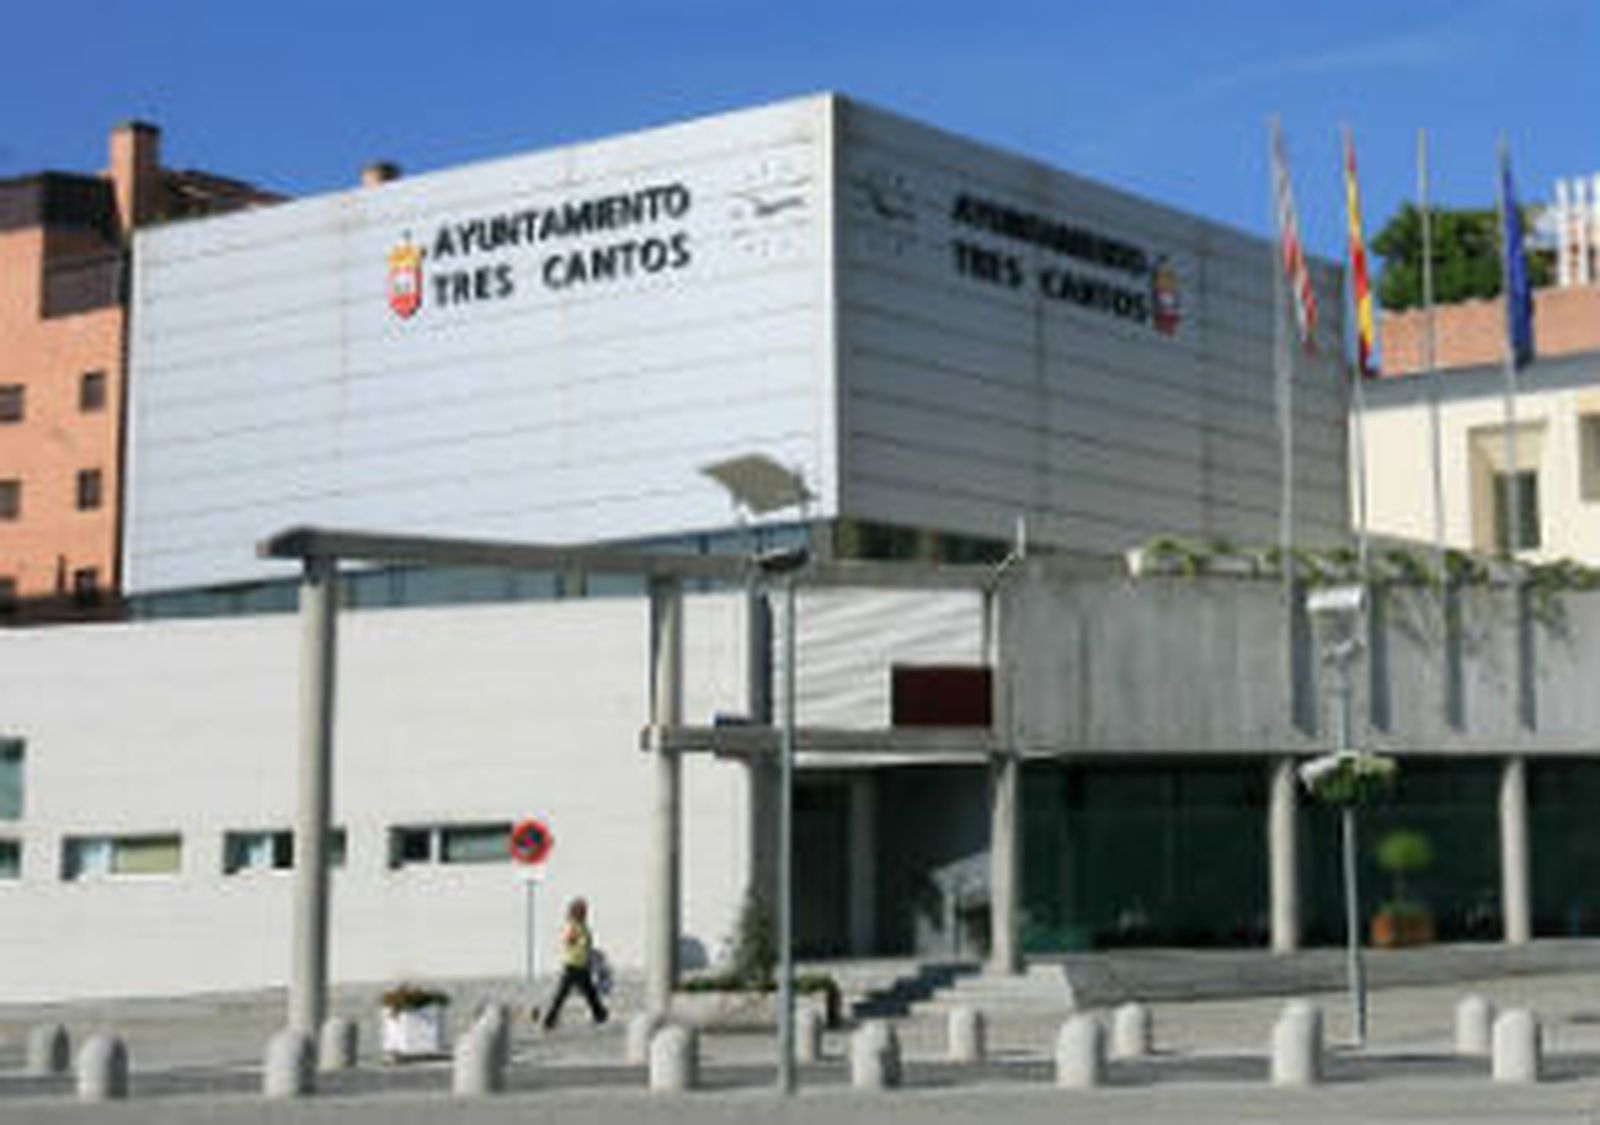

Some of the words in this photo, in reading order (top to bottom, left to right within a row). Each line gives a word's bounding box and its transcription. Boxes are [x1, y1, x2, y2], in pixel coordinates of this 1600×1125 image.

[433, 183, 691, 261] AYUNTAMIENTO
[434, 266, 514, 308] TRES
[542, 235, 692, 290] CANTOS
